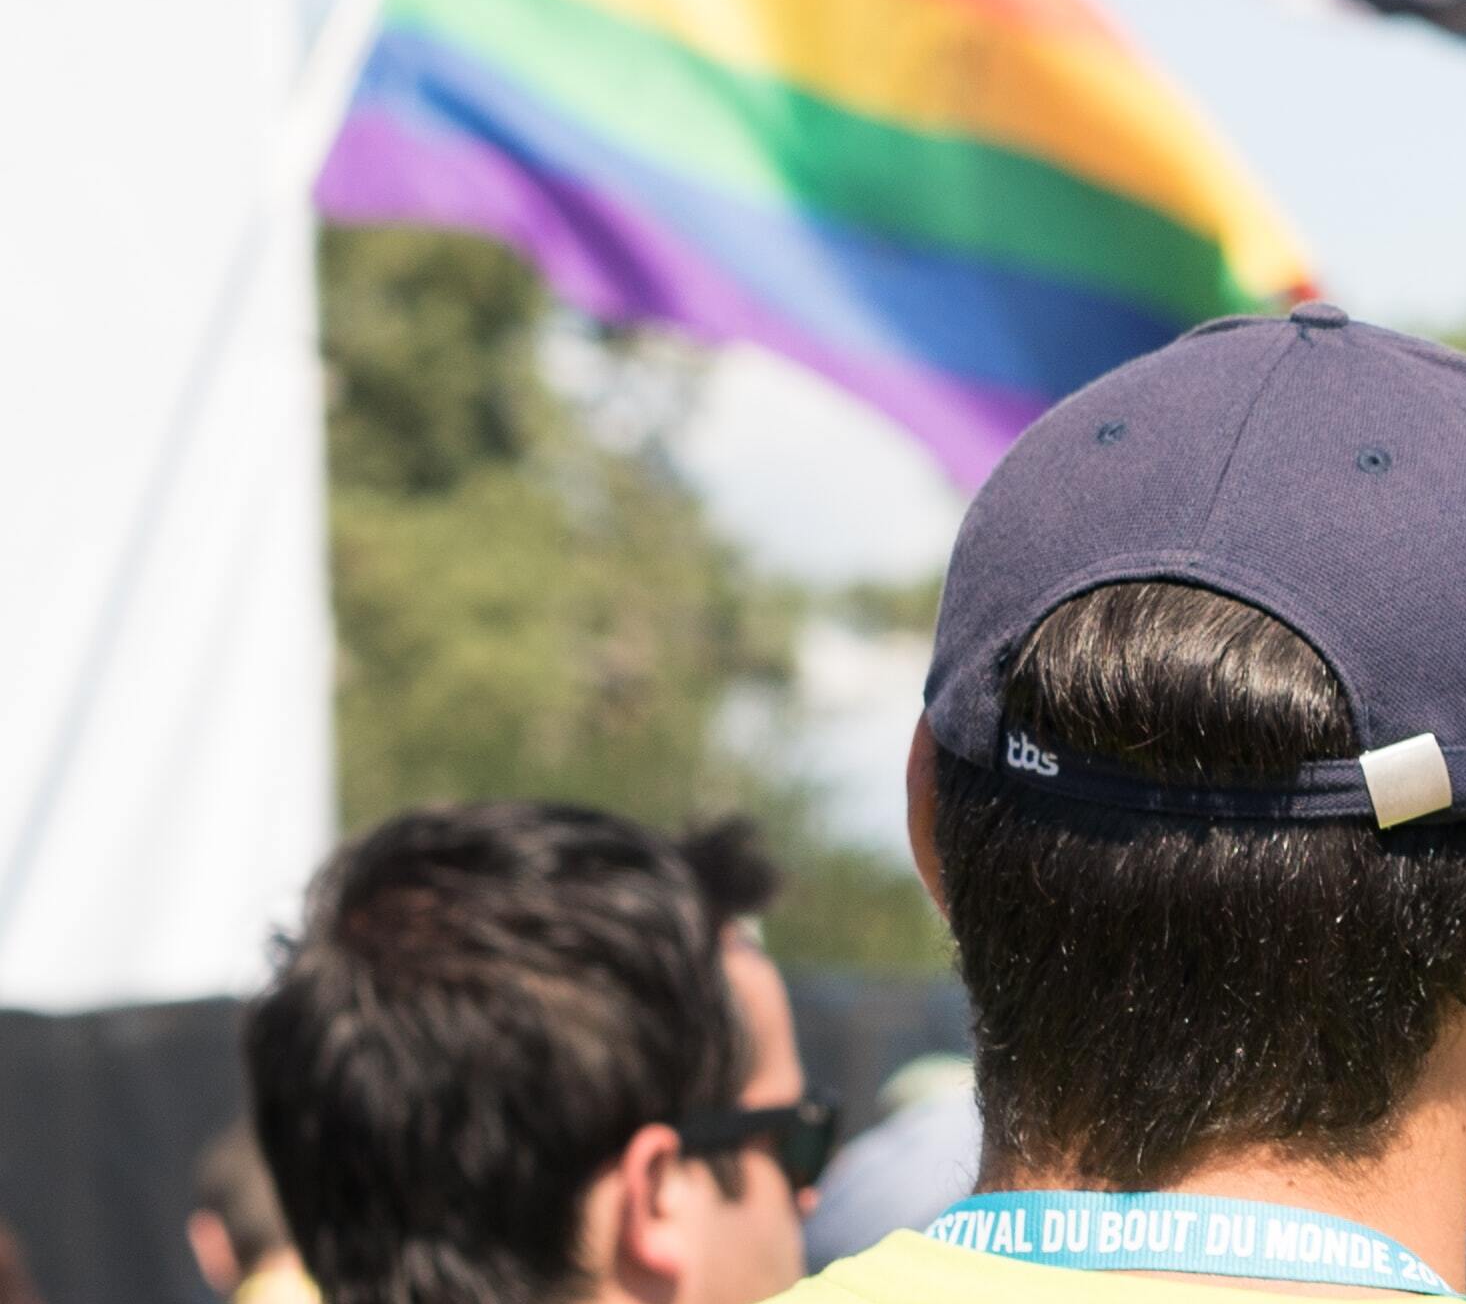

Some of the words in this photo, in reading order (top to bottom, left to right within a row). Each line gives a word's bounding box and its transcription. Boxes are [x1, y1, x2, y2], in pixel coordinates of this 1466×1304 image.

[1006, 729, 1060, 777] tbs
[1040, 1208, 1089, 1252] DU
[1099, 1207, 1196, 1254] BOUT
[1204, 1213, 1254, 1257] DU
[1264, 1220, 1393, 1275] MONDE
